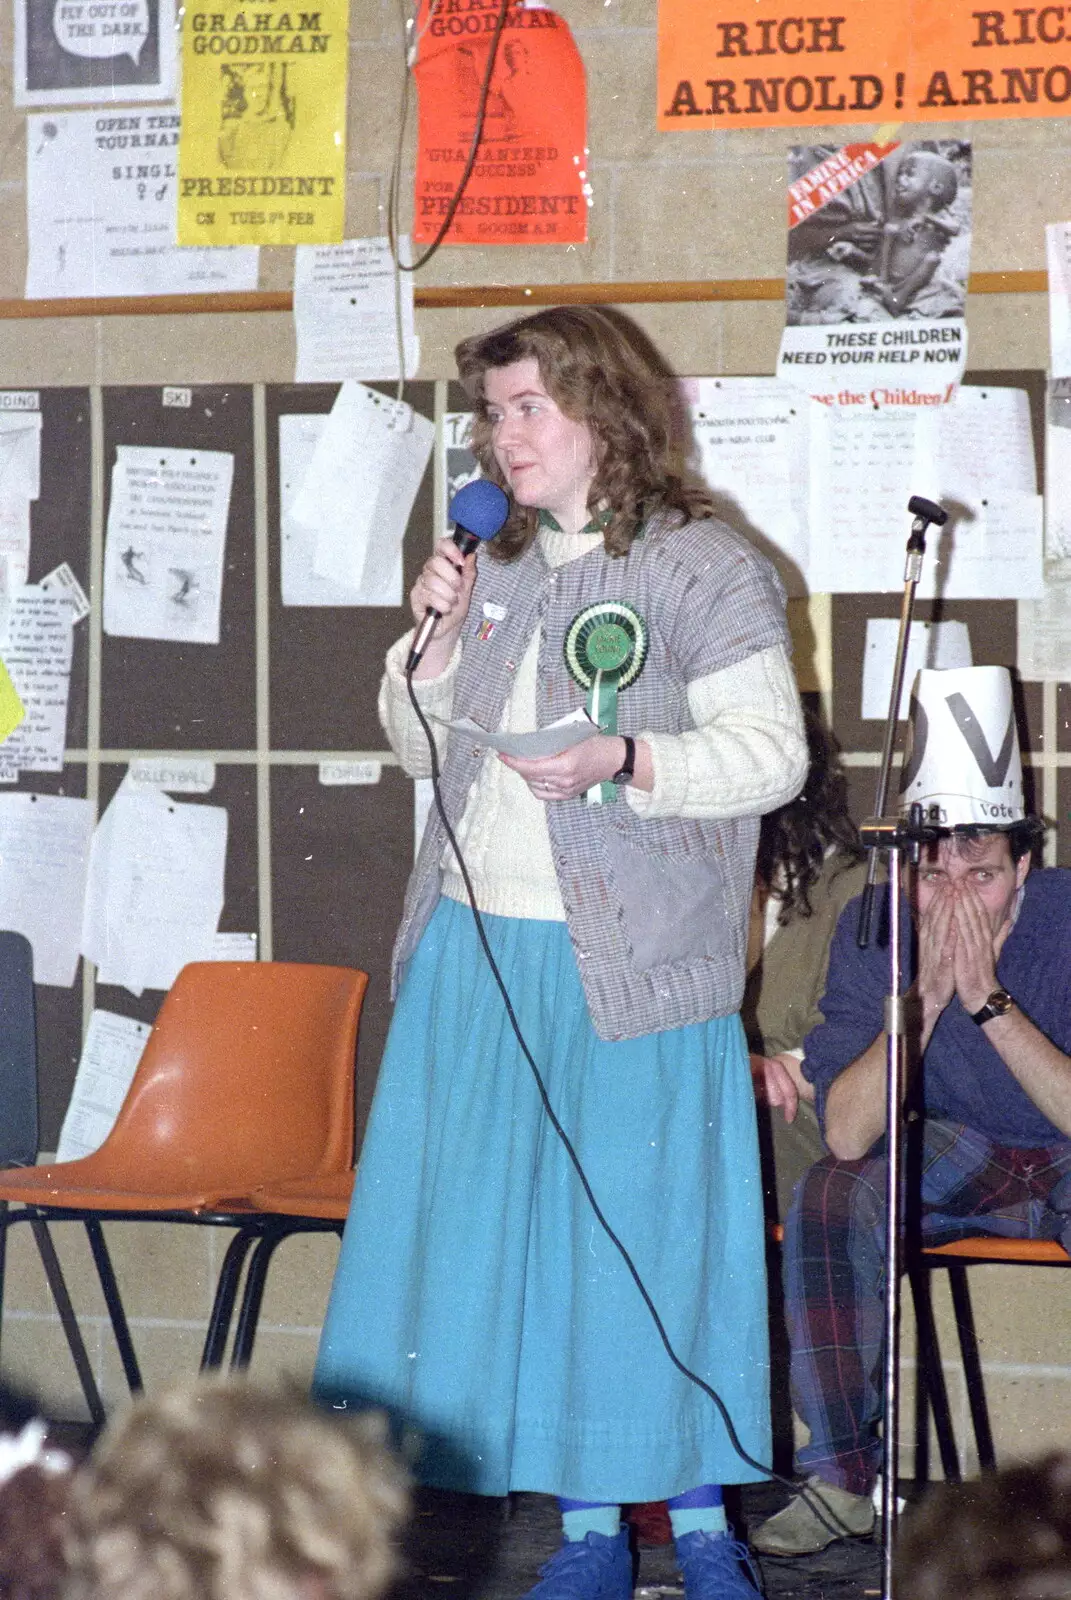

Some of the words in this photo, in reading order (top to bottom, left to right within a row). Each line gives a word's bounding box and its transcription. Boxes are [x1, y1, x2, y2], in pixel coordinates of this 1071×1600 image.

[88, 4, 116, 18] OUT
[120, 3, 138, 17] OF
[67, 23, 95, 37] THE
[192, 12, 321, 32] GRAHAM
[972, 6, 1071, 47] RIC
[193, 34, 331, 55] GOODMAN
[716, 16, 846, 58] RICH
[95, 117, 141, 132] OPEN
[181, 176, 335, 197] PRESIDENT
[423, 181, 454, 193] FOR
[196, 211, 216, 225] ON
[229, 211, 266, 226] TUES
[288, 211, 315, 226] FEB
[826, 333, 877, 347] THESE
[882, 327, 961, 346] CHILDREN
[782, 352, 827, 365] NEED
[831, 350, 875, 364] YOUR
[878, 350, 920, 363] HELP
[923, 348, 961, 363] NOW
[837, 389, 866, 405] the
